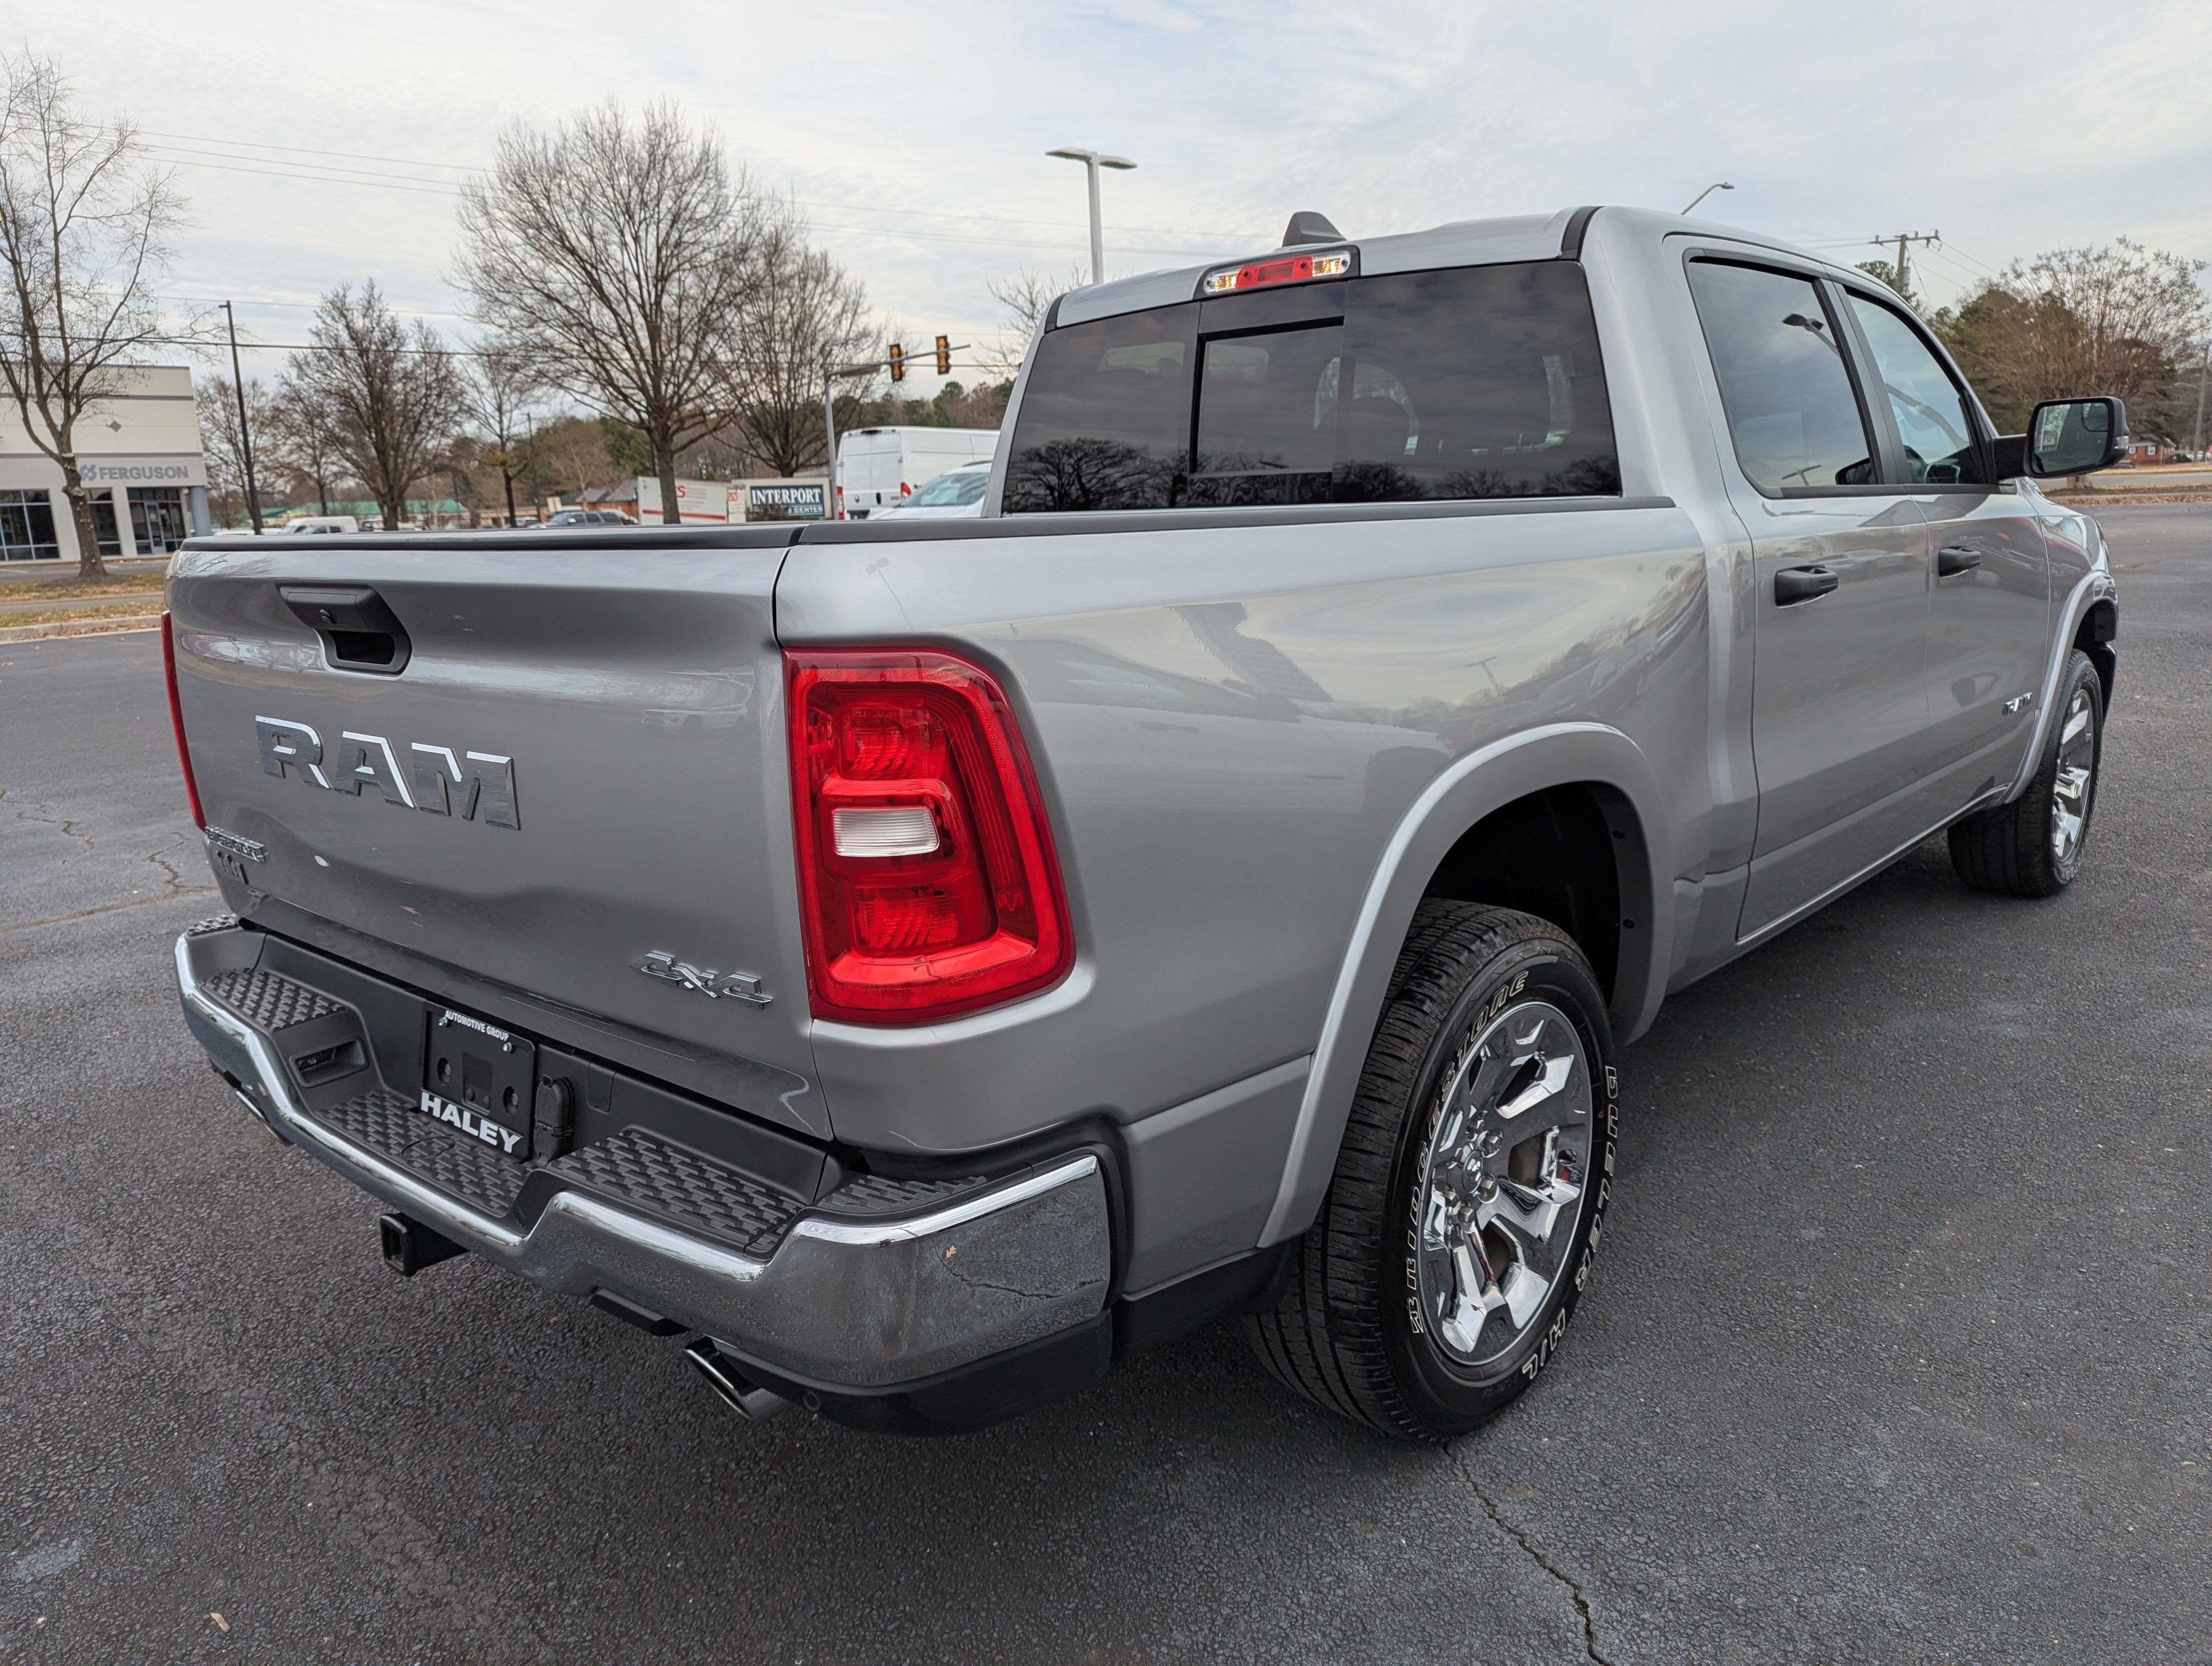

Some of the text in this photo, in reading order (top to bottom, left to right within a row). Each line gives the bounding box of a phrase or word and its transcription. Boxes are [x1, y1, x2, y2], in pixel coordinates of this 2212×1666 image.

[99, 466, 189, 479] FERGUSON
[751, 488, 821, 504] INTERPORT
[255, 715, 521, 830] RAM
[445, 1010, 509, 1041] AUTOMOTIVE GROUP
[420, 1091, 521, 1154] HALEY
[1406, 970, 1529, 1334] BRIDGESTONE
[1576, 1065, 1618, 1292] DUELER
